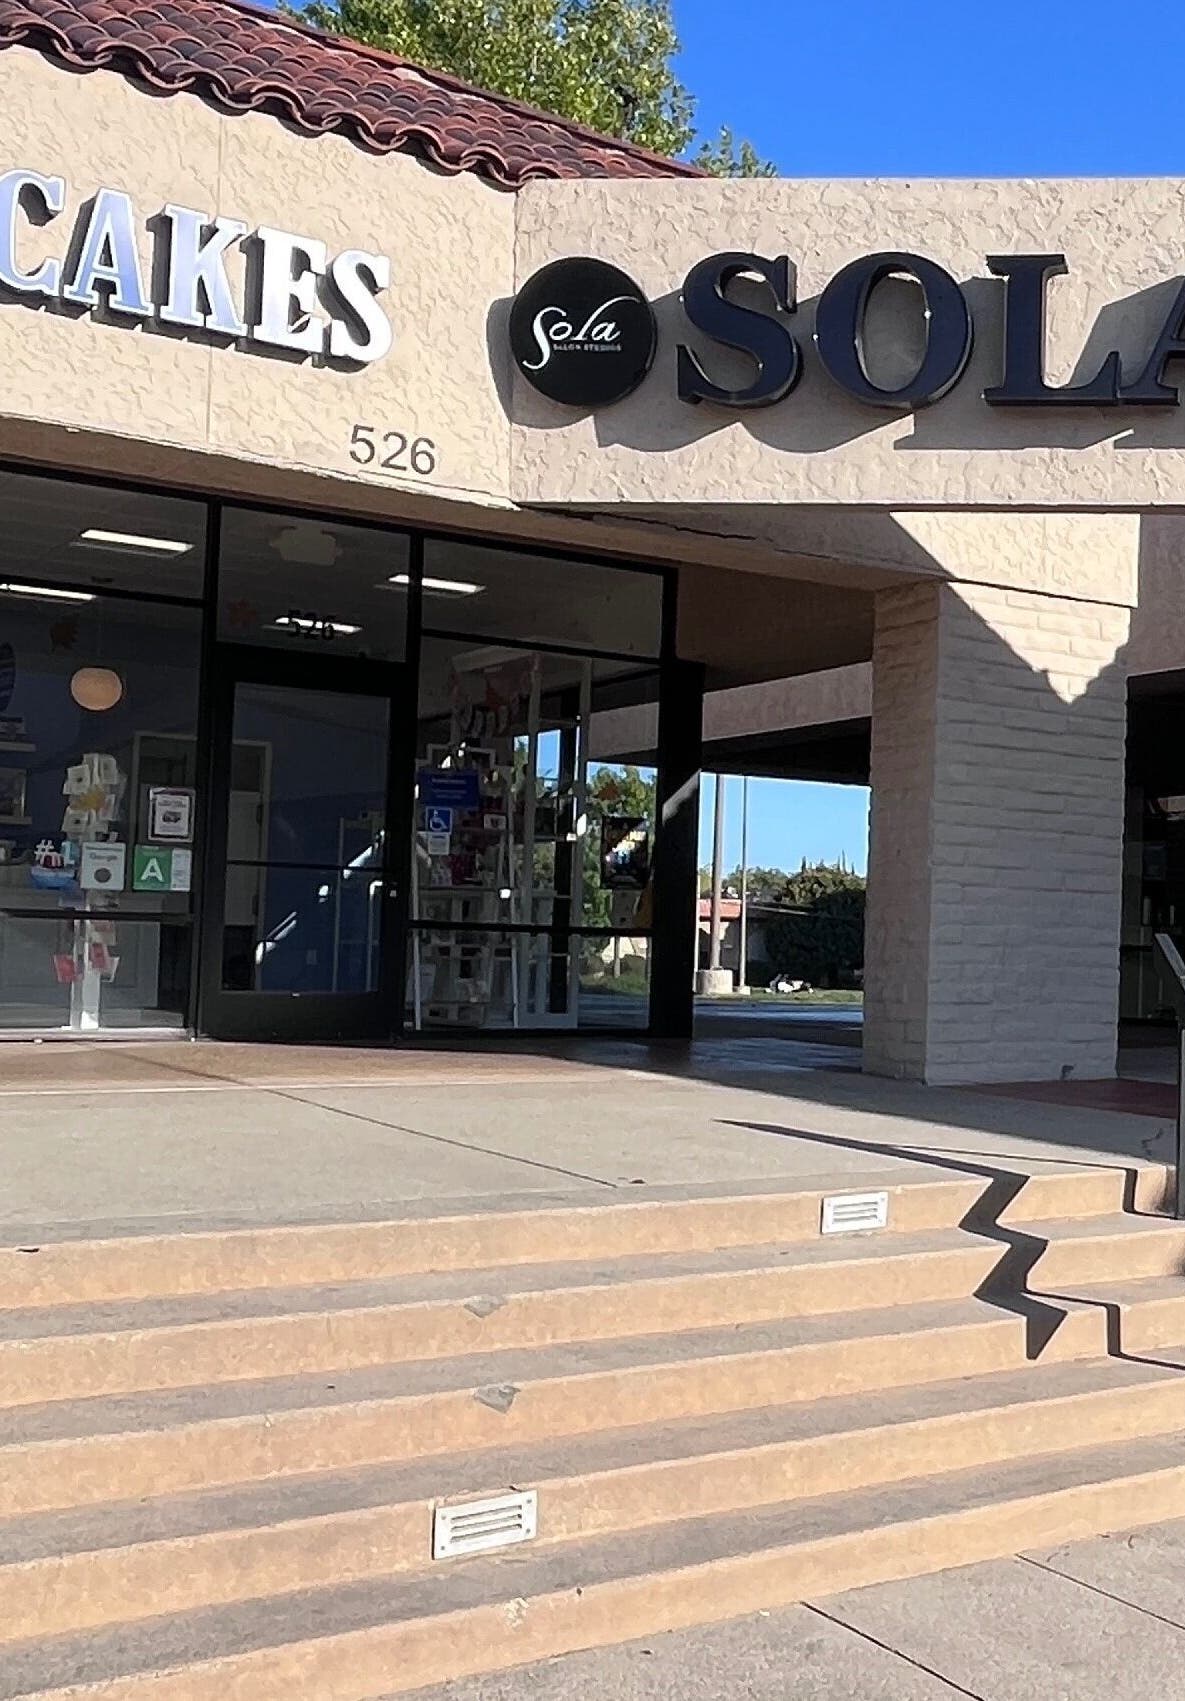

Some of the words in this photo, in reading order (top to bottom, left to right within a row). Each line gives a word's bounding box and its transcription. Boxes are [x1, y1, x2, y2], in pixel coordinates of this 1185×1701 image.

[0, 168, 394, 368] CAKES
[522, 296, 641, 369] Sola
[348, 424, 437, 476] 526
[287, 609, 335, 641] 526
[140, 857, 165, 883] A
